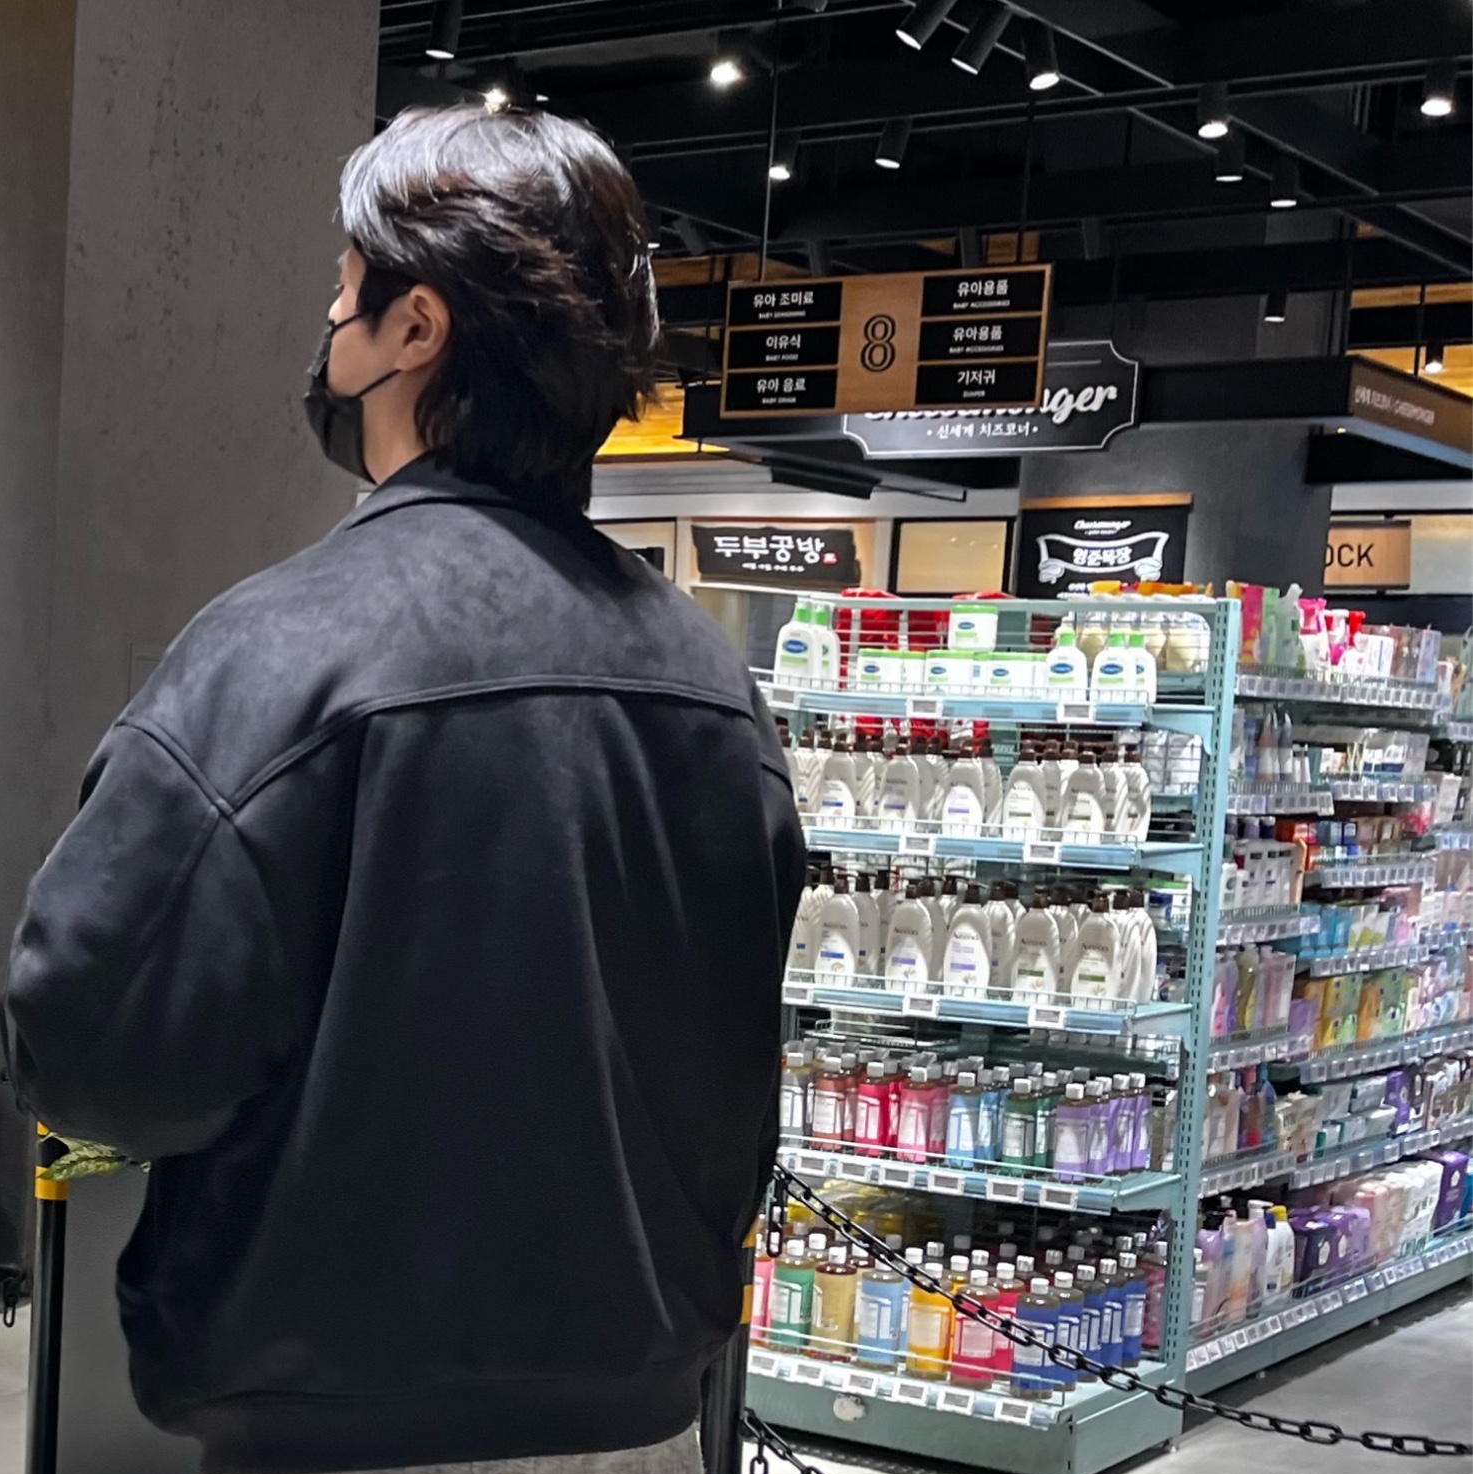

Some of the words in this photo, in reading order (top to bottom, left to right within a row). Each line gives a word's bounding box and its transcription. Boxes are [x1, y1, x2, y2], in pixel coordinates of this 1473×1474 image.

[957, 279, 1009, 297] 유아용품
[753, 293, 776, 308] 유아
[779, 291, 814, 307] 조미료
[952, 302, 969, 310] BABY
[766, 334, 802, 350] 이유식
[952, 325, 1003, 342] 유아용품
[860, 314, 896, 372] 8
[948, 346, 964, 354] BABY
[756, 379, 779, 393] 유아
[782, 377, 806, 393] 음료
[957, 369, 996, 385] 기저귀
[936, 424, 975, 440] 신세계
[978, 421, 1031, 438] 치즈코너
[713, 535, 825, 564] 두부공방
